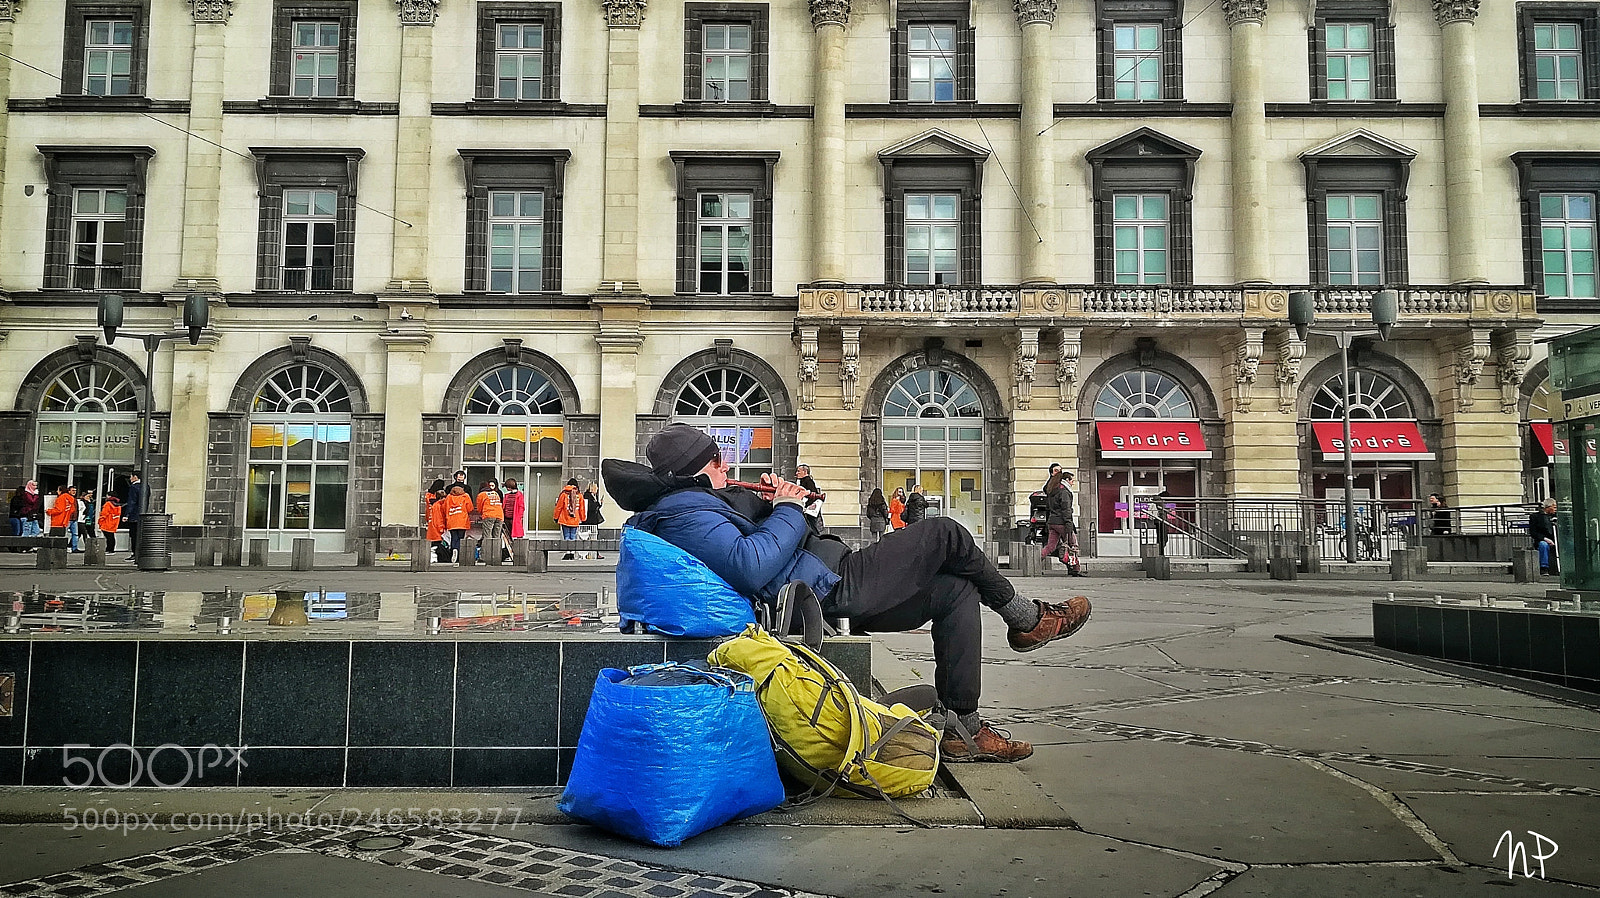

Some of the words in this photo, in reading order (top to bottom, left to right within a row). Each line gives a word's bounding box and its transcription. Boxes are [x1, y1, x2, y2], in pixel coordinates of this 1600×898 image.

[42, 435, 82, 443] BANQE
[84, 435, 130, 444] CHLUS
[711, 434, 736, 445] ALUS
